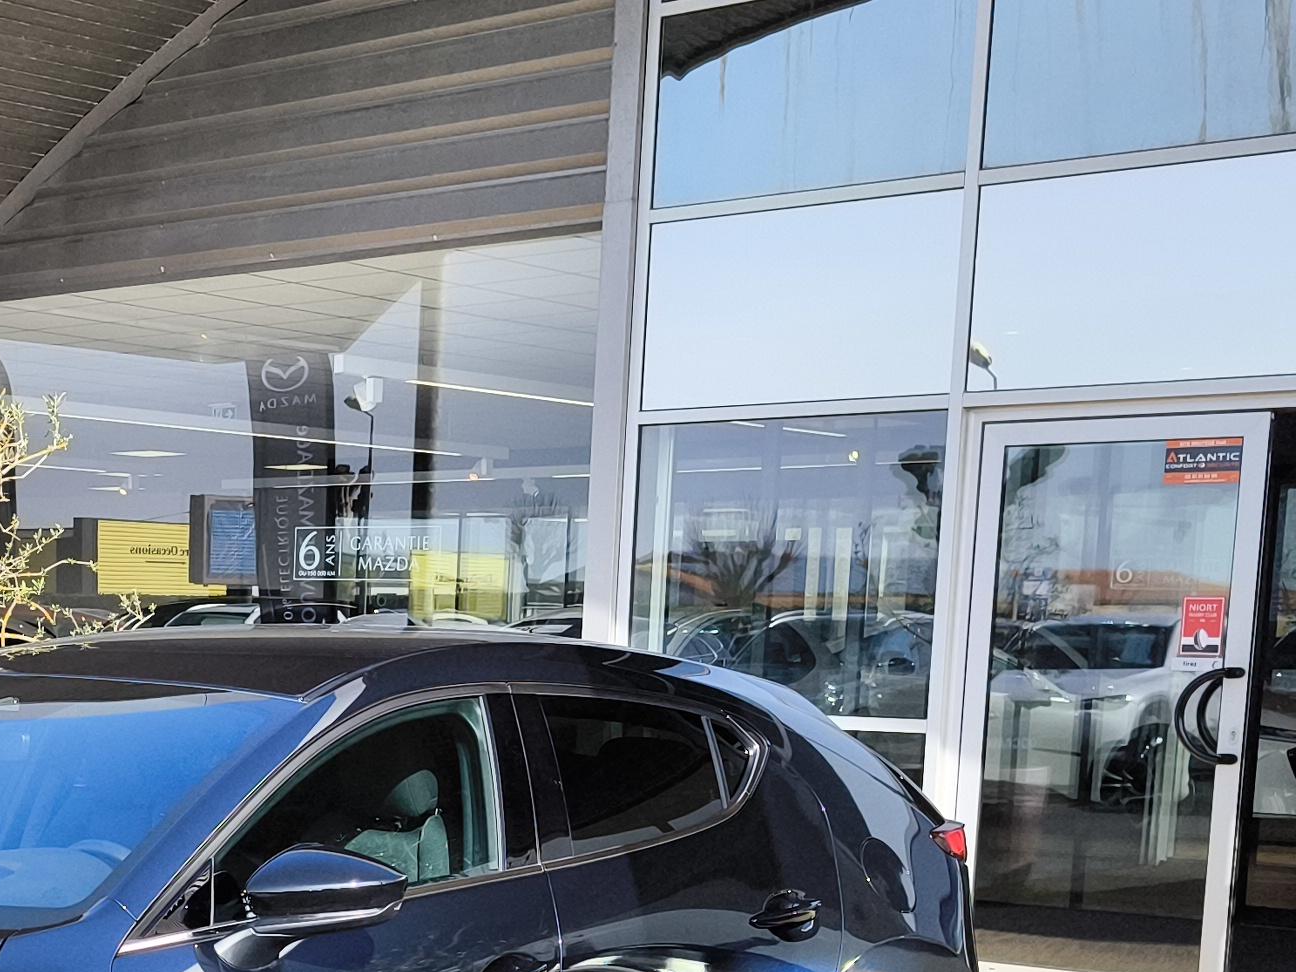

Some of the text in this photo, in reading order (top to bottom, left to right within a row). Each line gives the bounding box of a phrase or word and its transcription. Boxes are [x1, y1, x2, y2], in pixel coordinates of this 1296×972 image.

[1167, 451, 1240, 463] ATLANTIC
[299, 531, 336, 570] 6 ANS
[350, 535, 430, 551] GARANTIE
[357, 556, 420, 572] MAZDA
[1189, 604, 1218, 612] NIORT
